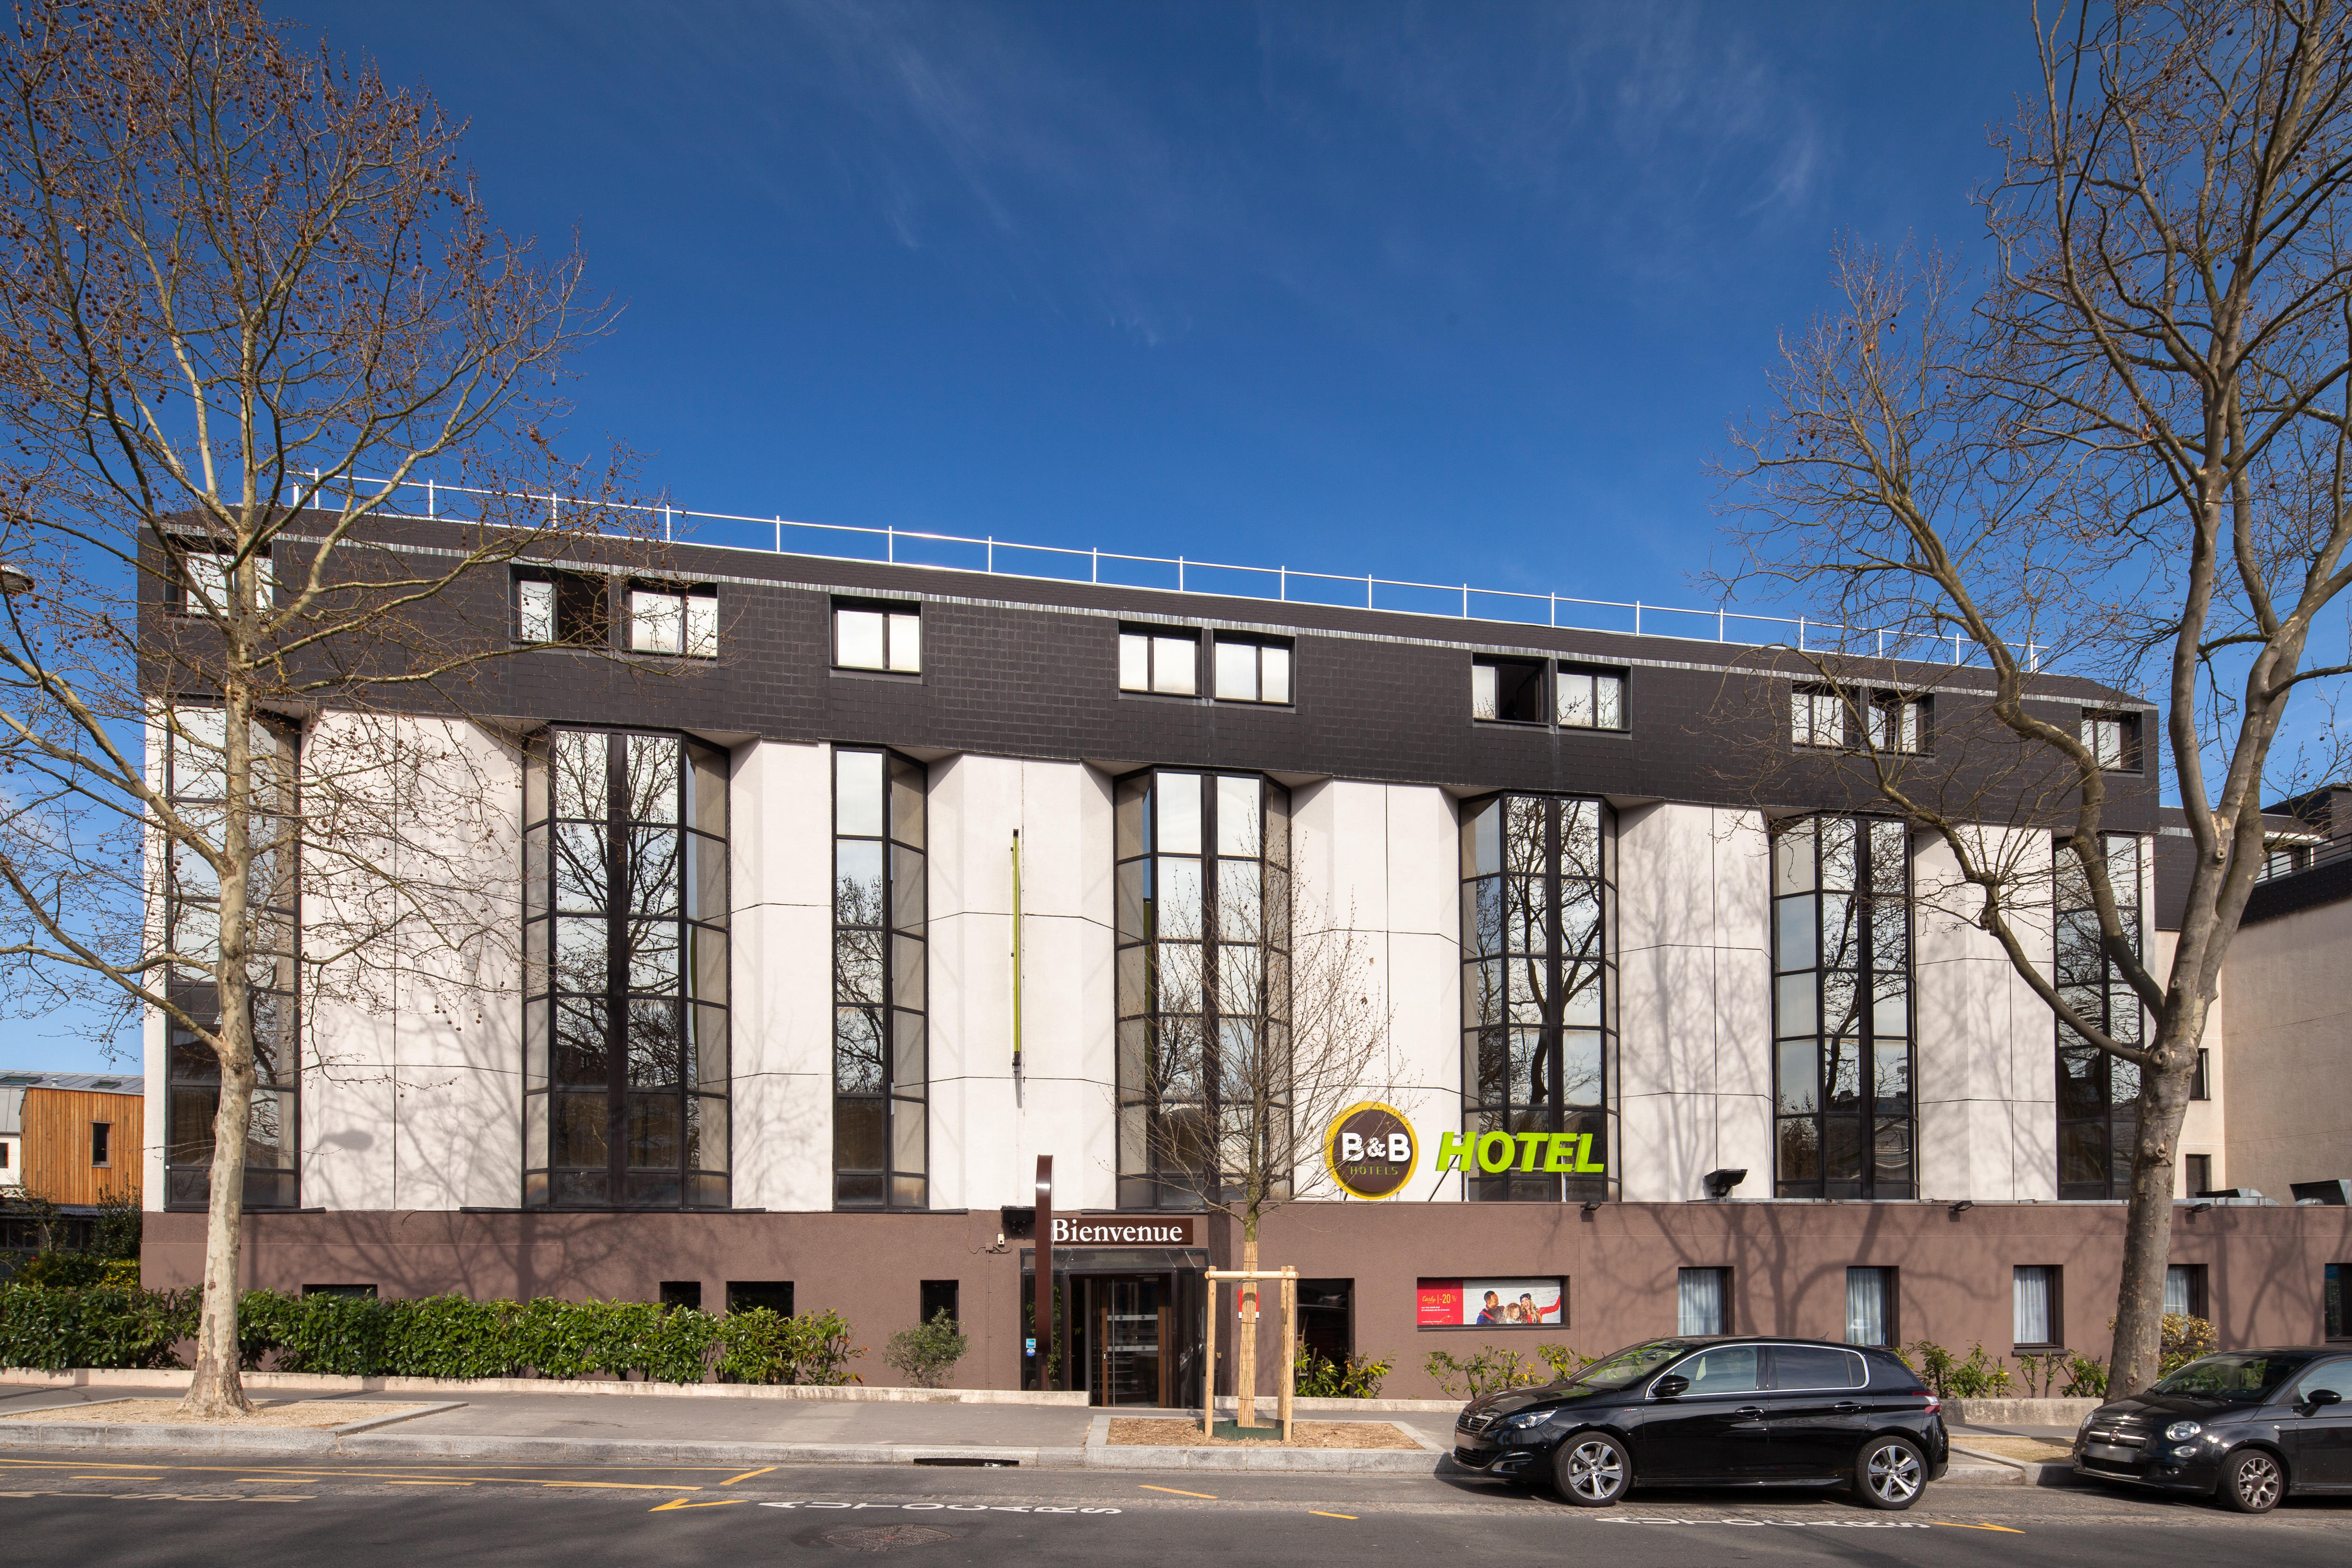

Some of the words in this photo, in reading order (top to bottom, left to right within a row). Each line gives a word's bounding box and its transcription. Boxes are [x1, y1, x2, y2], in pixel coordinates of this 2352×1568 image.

[1342, 1132, 1411, 1162] B&B
[1435, 1131, 1605, 1173] HOTEL
[1350, 1166, 1398, 1175] HOTELS
[1052, 1218, 1183, 1242] Bienvenue
[1422, 1295, 1436, 1304] Early
[757, 1501, 1123, 1514] AUTOCARS
[1595, 1517, 1931, 1528] AUTOCARS
